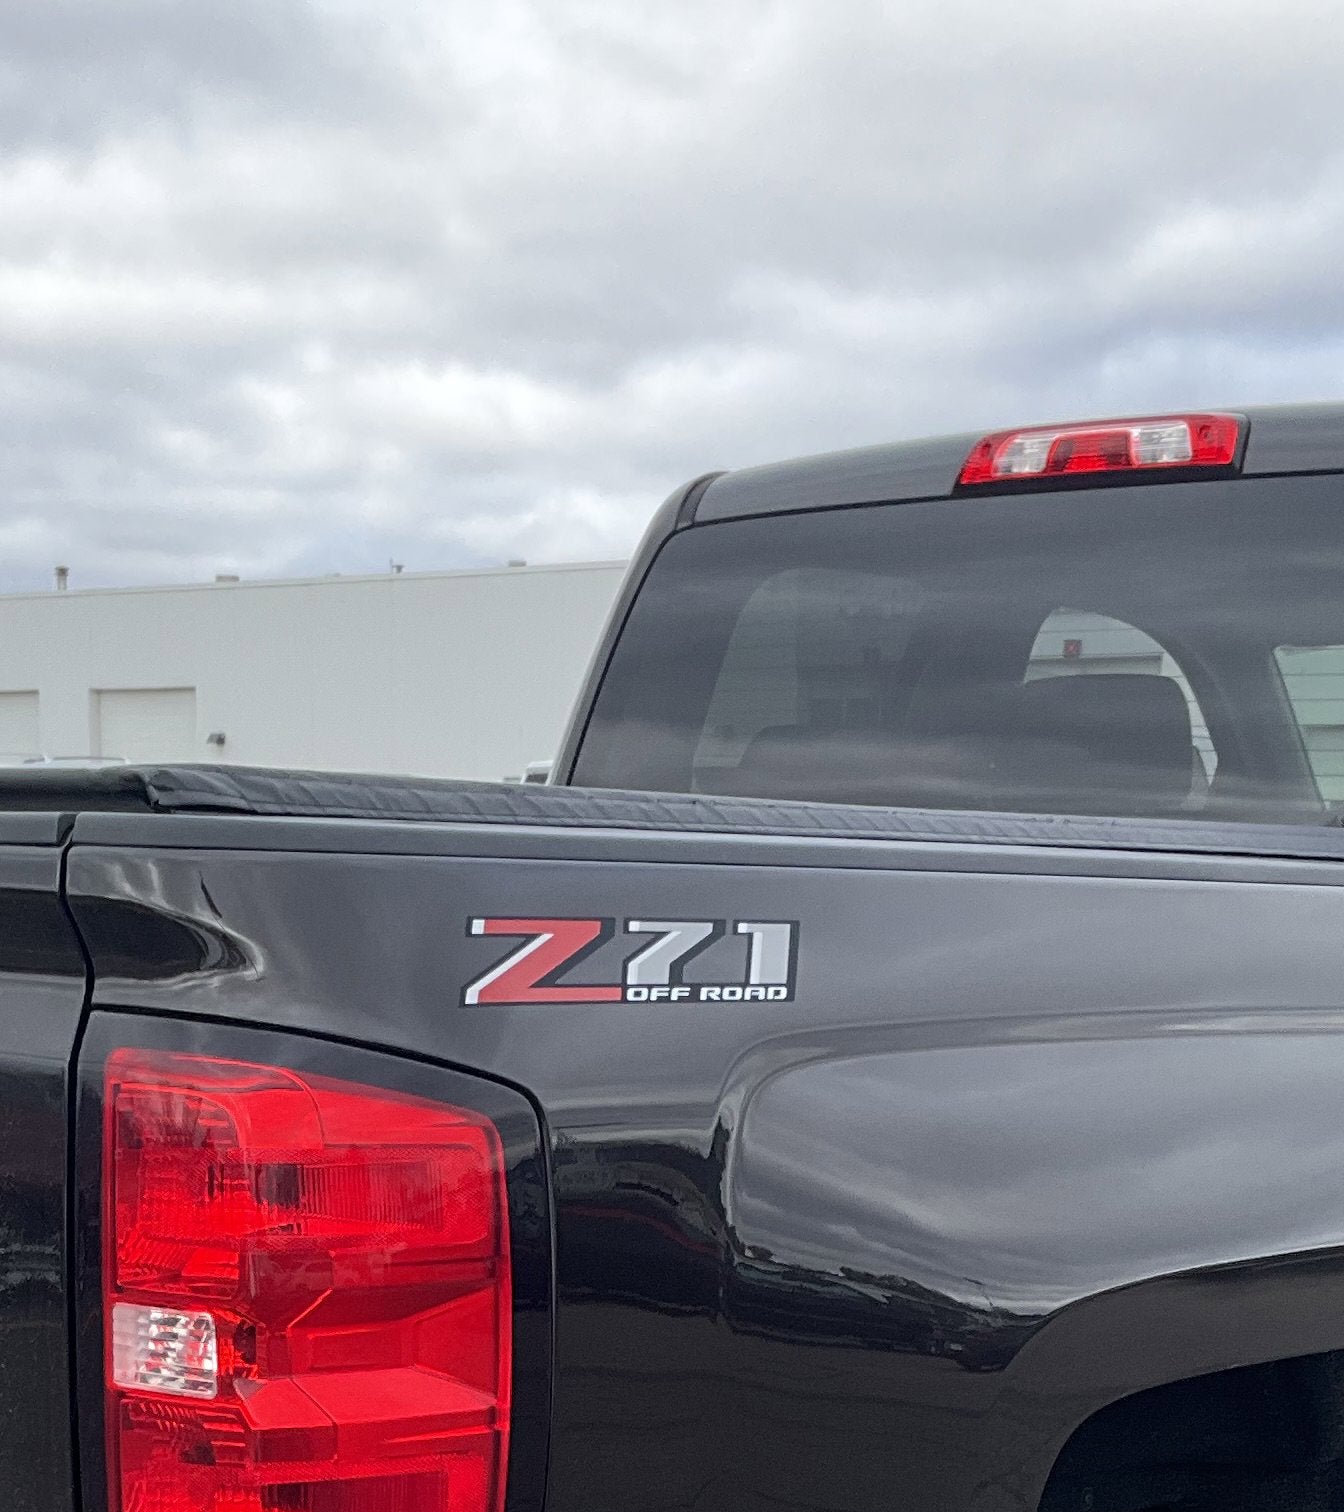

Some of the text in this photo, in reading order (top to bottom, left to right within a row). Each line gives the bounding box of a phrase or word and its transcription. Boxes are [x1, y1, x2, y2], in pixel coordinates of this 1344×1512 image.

[461, 917, 797, 1006] Z71
[626, 986, 788, 1001] OFF ROAD
